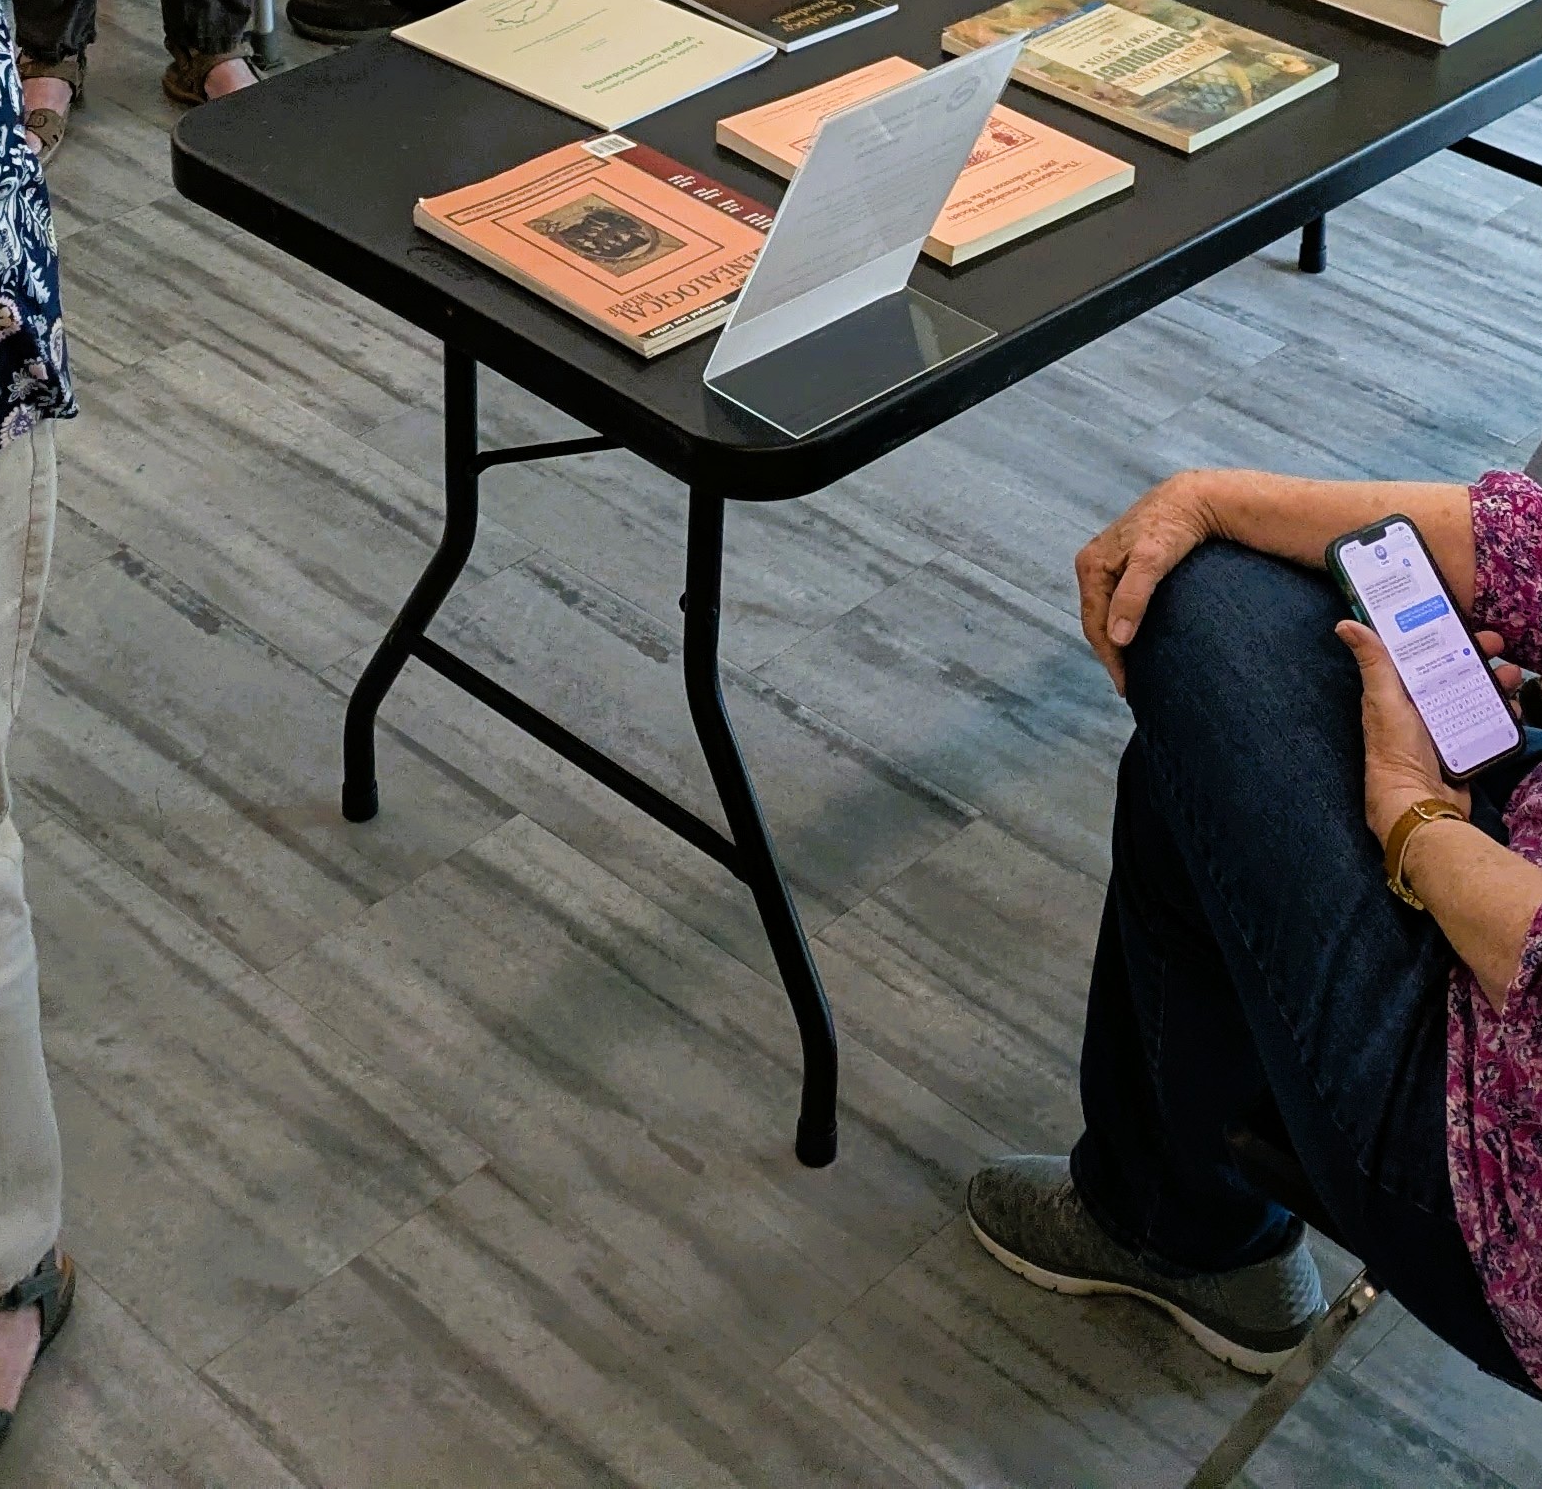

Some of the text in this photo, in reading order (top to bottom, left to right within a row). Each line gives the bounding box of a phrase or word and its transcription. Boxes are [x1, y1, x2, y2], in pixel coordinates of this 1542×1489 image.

[674, 43, 699, 56] Guide
[1081, 28, 1159, 66] COMPANION
[1087, 28, 1197, 84] computer
[579, 35, 696, 89] Virginia Court Handwriting
[990, 167, 1043, 191] Conference
[1024, 168, 1066, 187] National
[973, 183, 1031, 209] Genealogical
[943, 205, 980, 222] Society
[602, 291, 655, 317] HELPER
[647, 299, 727, 336] Intercepted Love Letters
